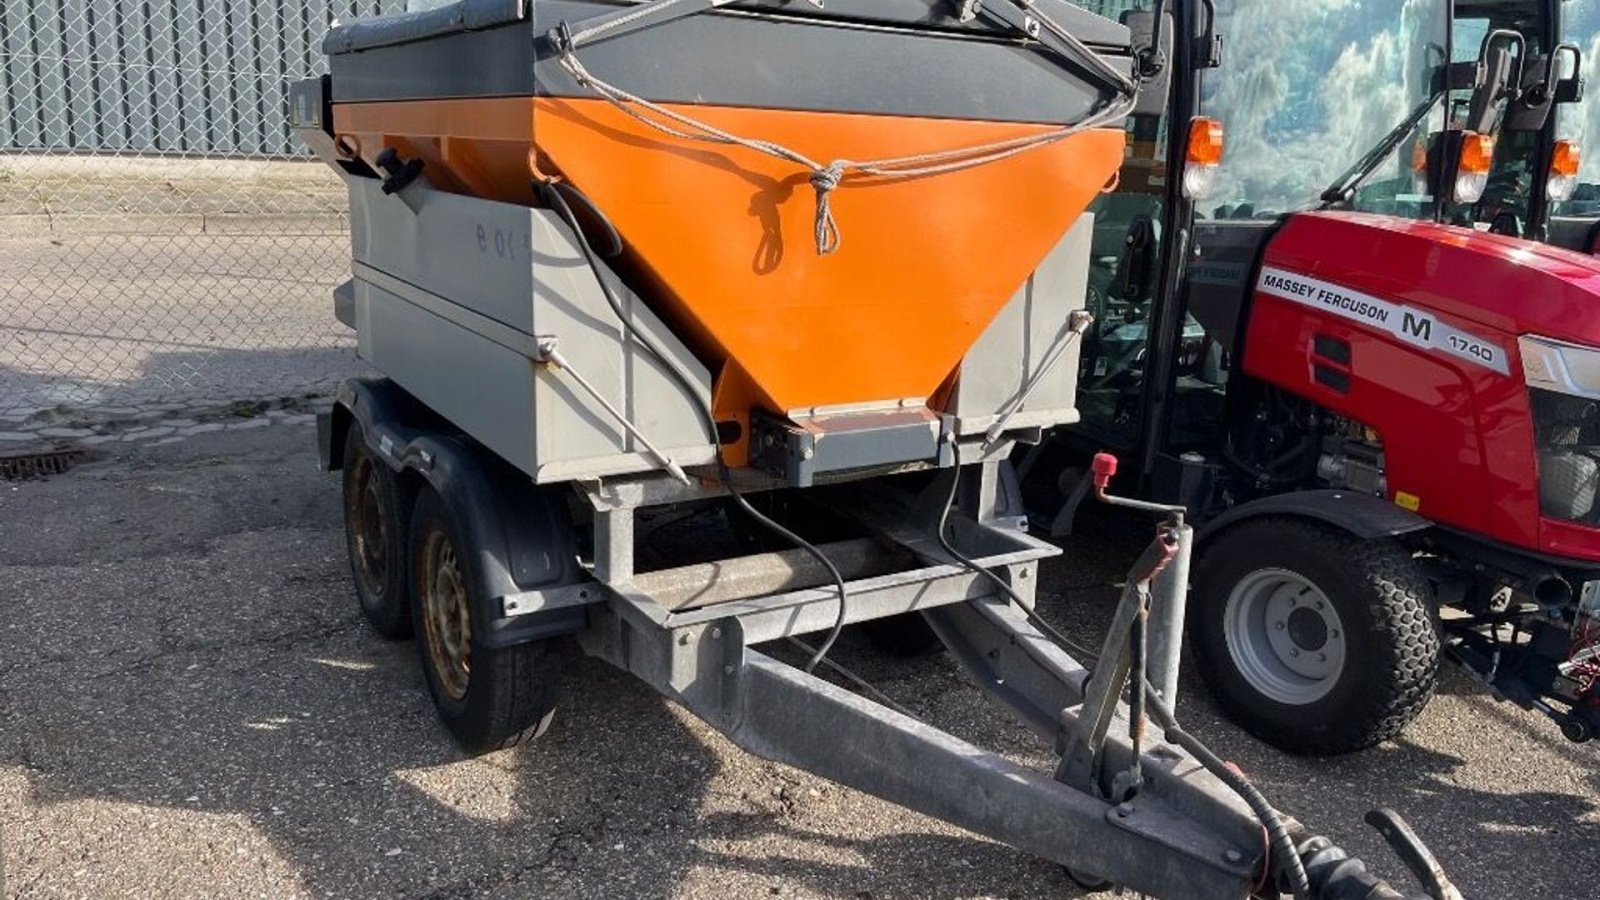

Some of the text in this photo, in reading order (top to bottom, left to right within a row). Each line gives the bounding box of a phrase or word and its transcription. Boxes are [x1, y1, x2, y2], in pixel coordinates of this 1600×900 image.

[1264, 274, 1493, 362] MASSEY FERGUSON M 1740
